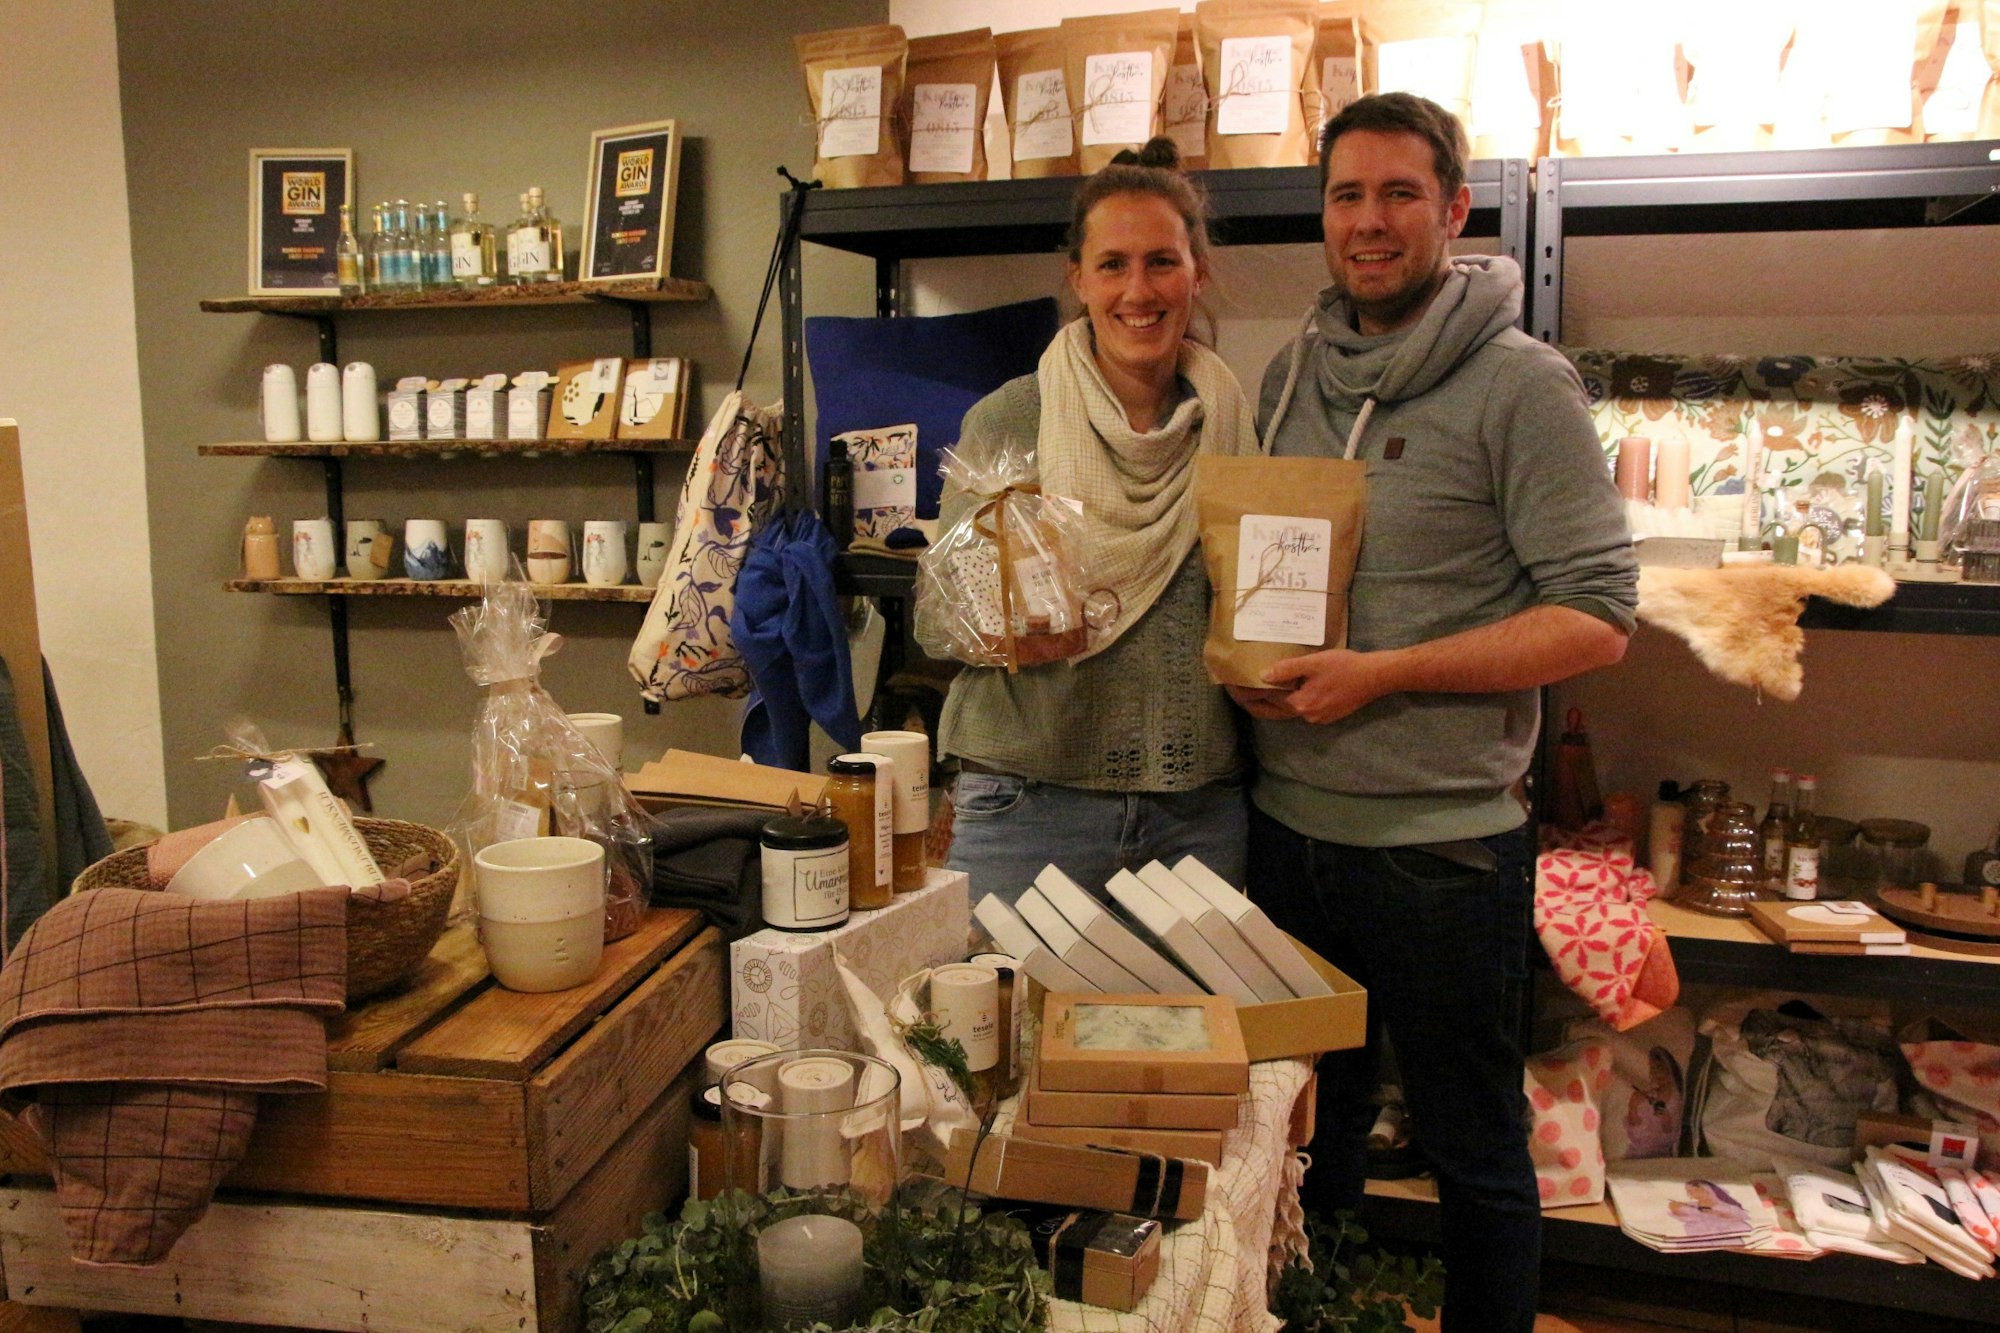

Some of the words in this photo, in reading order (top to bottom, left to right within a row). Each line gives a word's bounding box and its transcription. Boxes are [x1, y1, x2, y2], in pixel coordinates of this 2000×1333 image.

[621, 156, 650, 167] WORLD
[620, 165, 649, 182] GIN
[287, 179, 321, 187] WORLD
[620, 181, 647, 190] AWARDS
[287, 187, 321, 201] GIN
[287, 201, 321, 209] AWARDS
